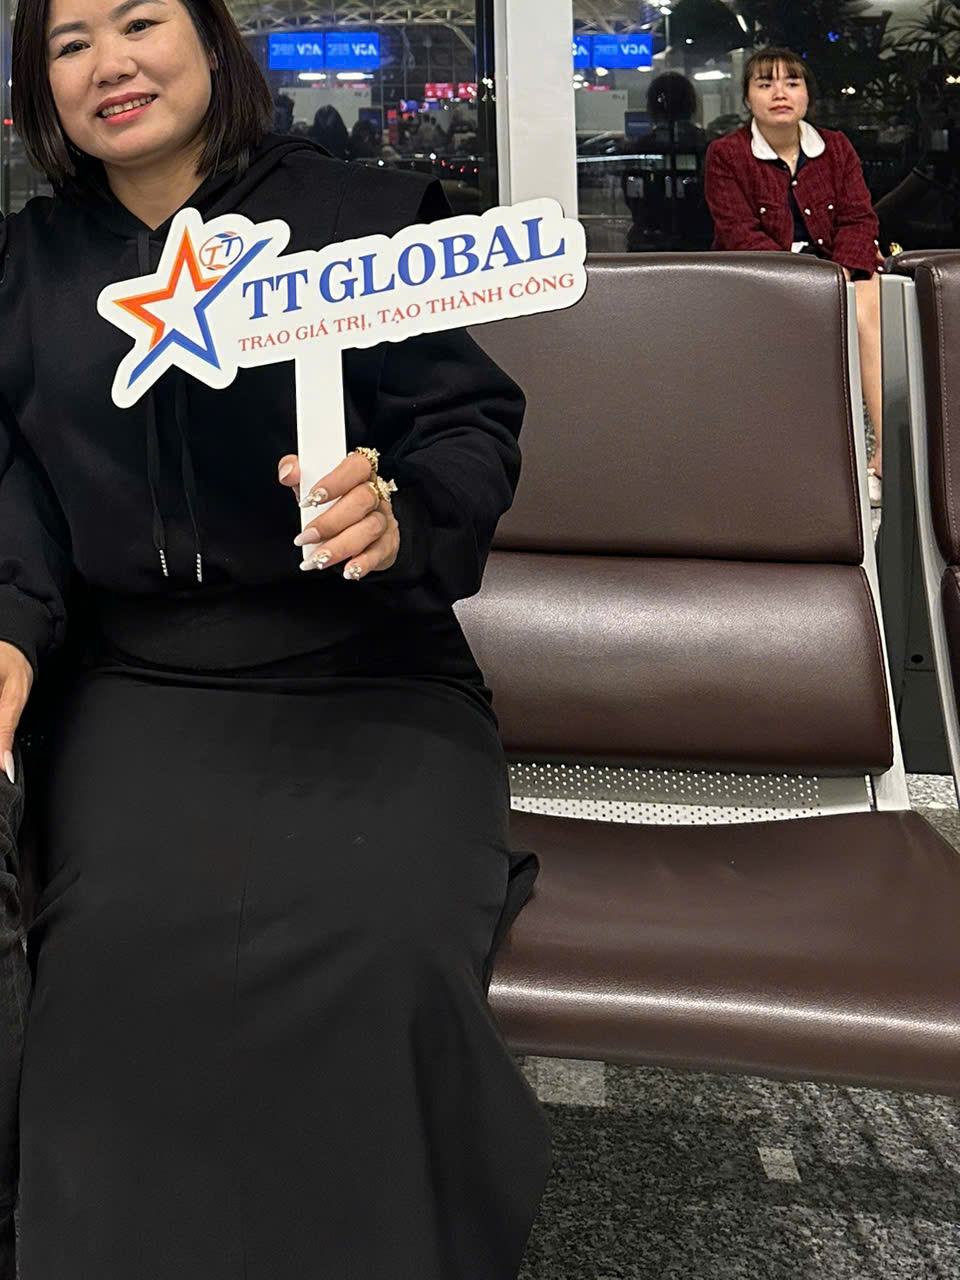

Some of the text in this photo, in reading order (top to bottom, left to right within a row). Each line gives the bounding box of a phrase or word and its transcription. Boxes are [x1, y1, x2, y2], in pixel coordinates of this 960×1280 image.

[238, 272, 576, 351] TRAO GIÁ TRỊ, TẠO THÀNH CÔNG
[242, 217, 565, 320] TT GLOBAL
